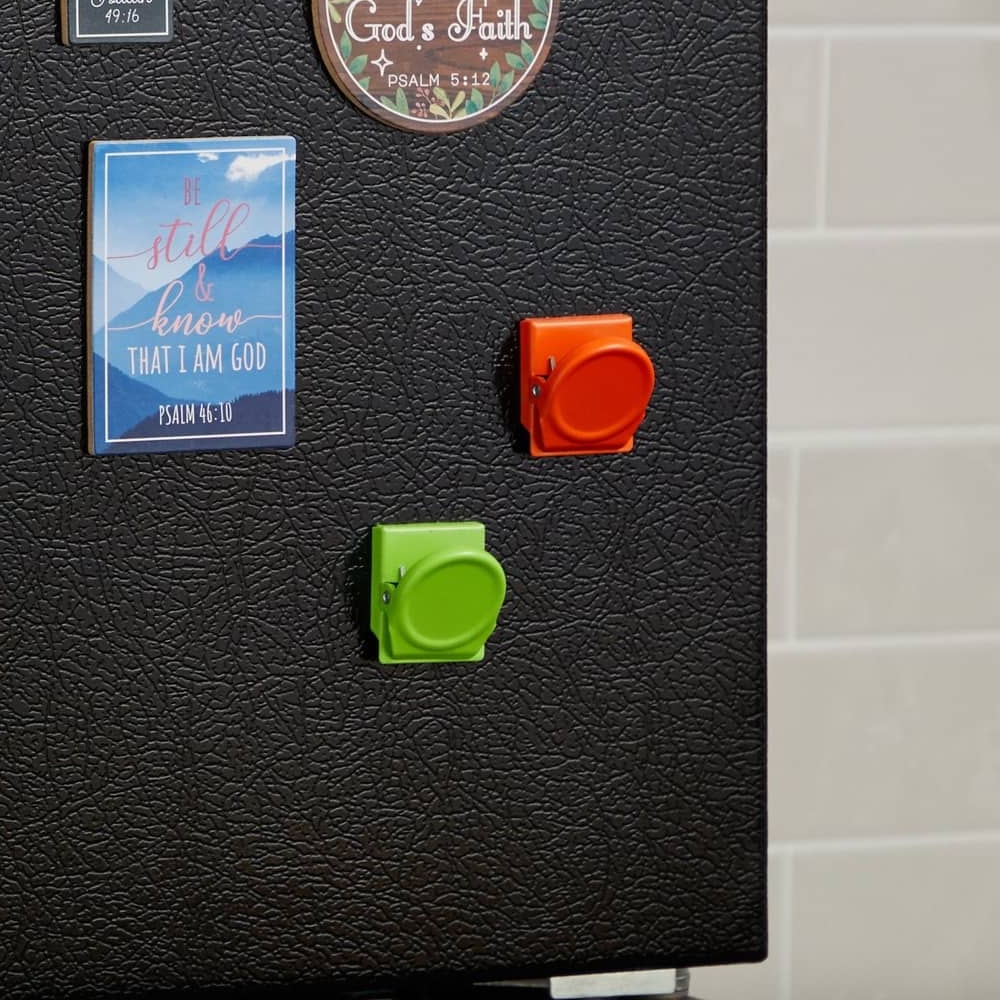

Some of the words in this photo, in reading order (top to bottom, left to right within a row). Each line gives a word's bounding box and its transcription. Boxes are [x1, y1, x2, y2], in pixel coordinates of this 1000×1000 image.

[105, 9, 139, 23] 49:16
[388, 74, 440, 87] PSALM
[451, 73, 490, 85] 5:12
[184, 177, 200, 206] BE
[107, 199, 281, 270] still
[195, 263, 214, 302] &
[107, 280, 281, 337] know
[128, 346, 171, 375] THAT
[178, 345, 186, 373] I
[193, 344, 223, 373] AM
[231, 342, 266, 371] GOD
[159, 404, 195, 426] PSALM
[199, 402, 232, 424] 46:10
